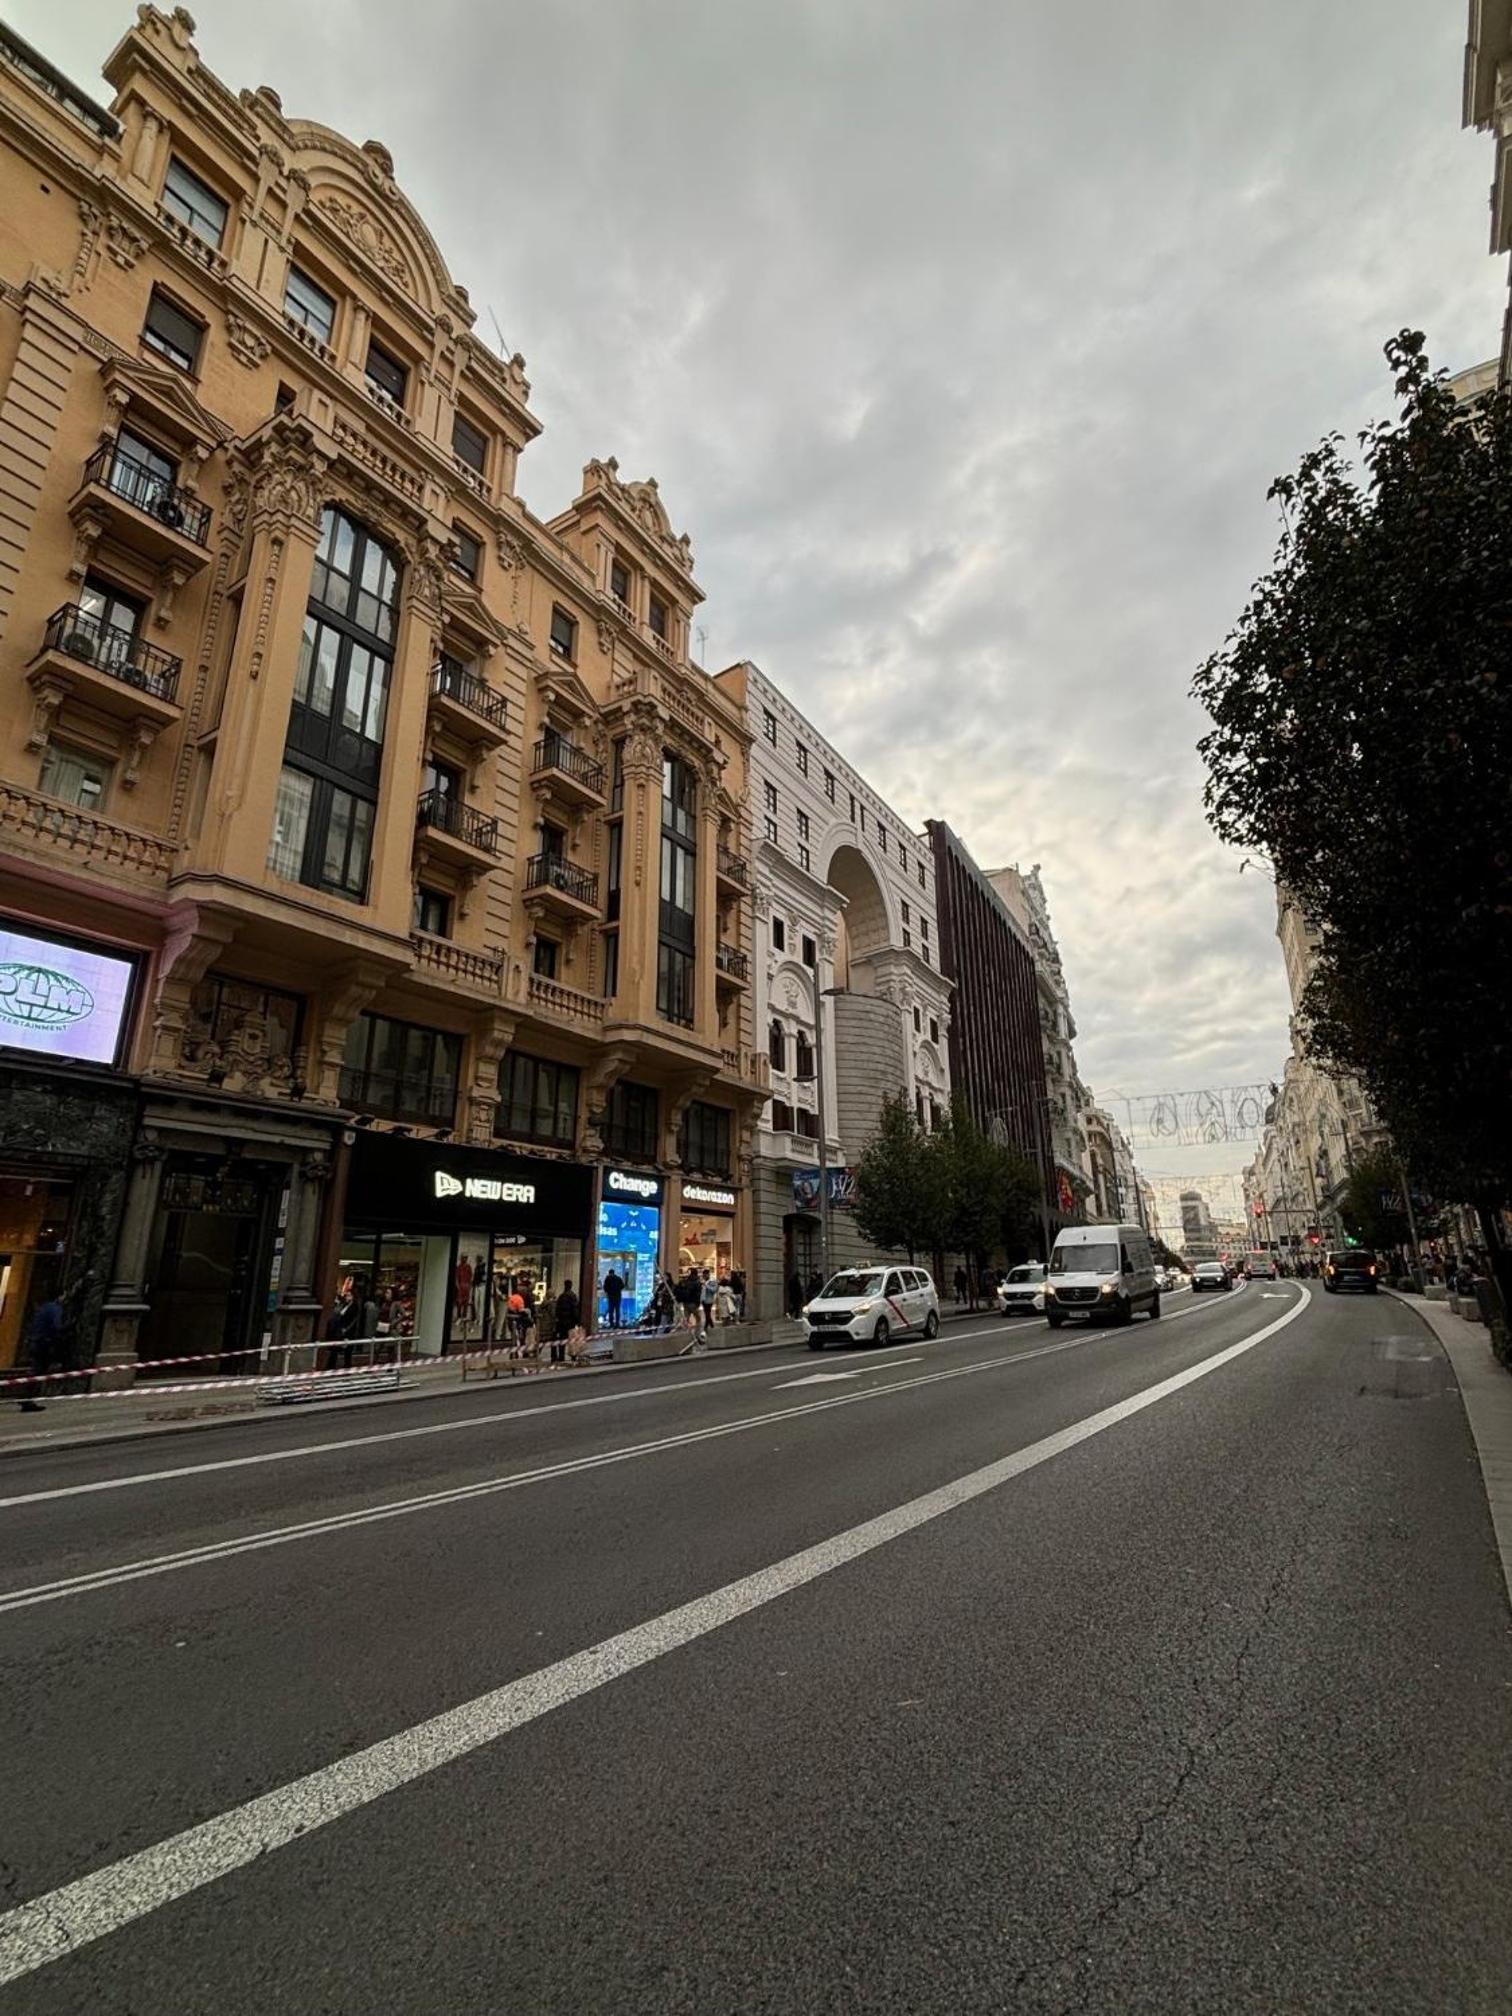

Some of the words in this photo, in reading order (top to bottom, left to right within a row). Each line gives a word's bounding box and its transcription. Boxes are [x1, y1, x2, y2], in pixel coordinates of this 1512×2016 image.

[465, 1178, 502, 1200] NEW
[502, 1183, 535, 1203] ERA
[609, 1171, 658, 1197] Change
[682, 1185, 734, 1205] dekorazon
